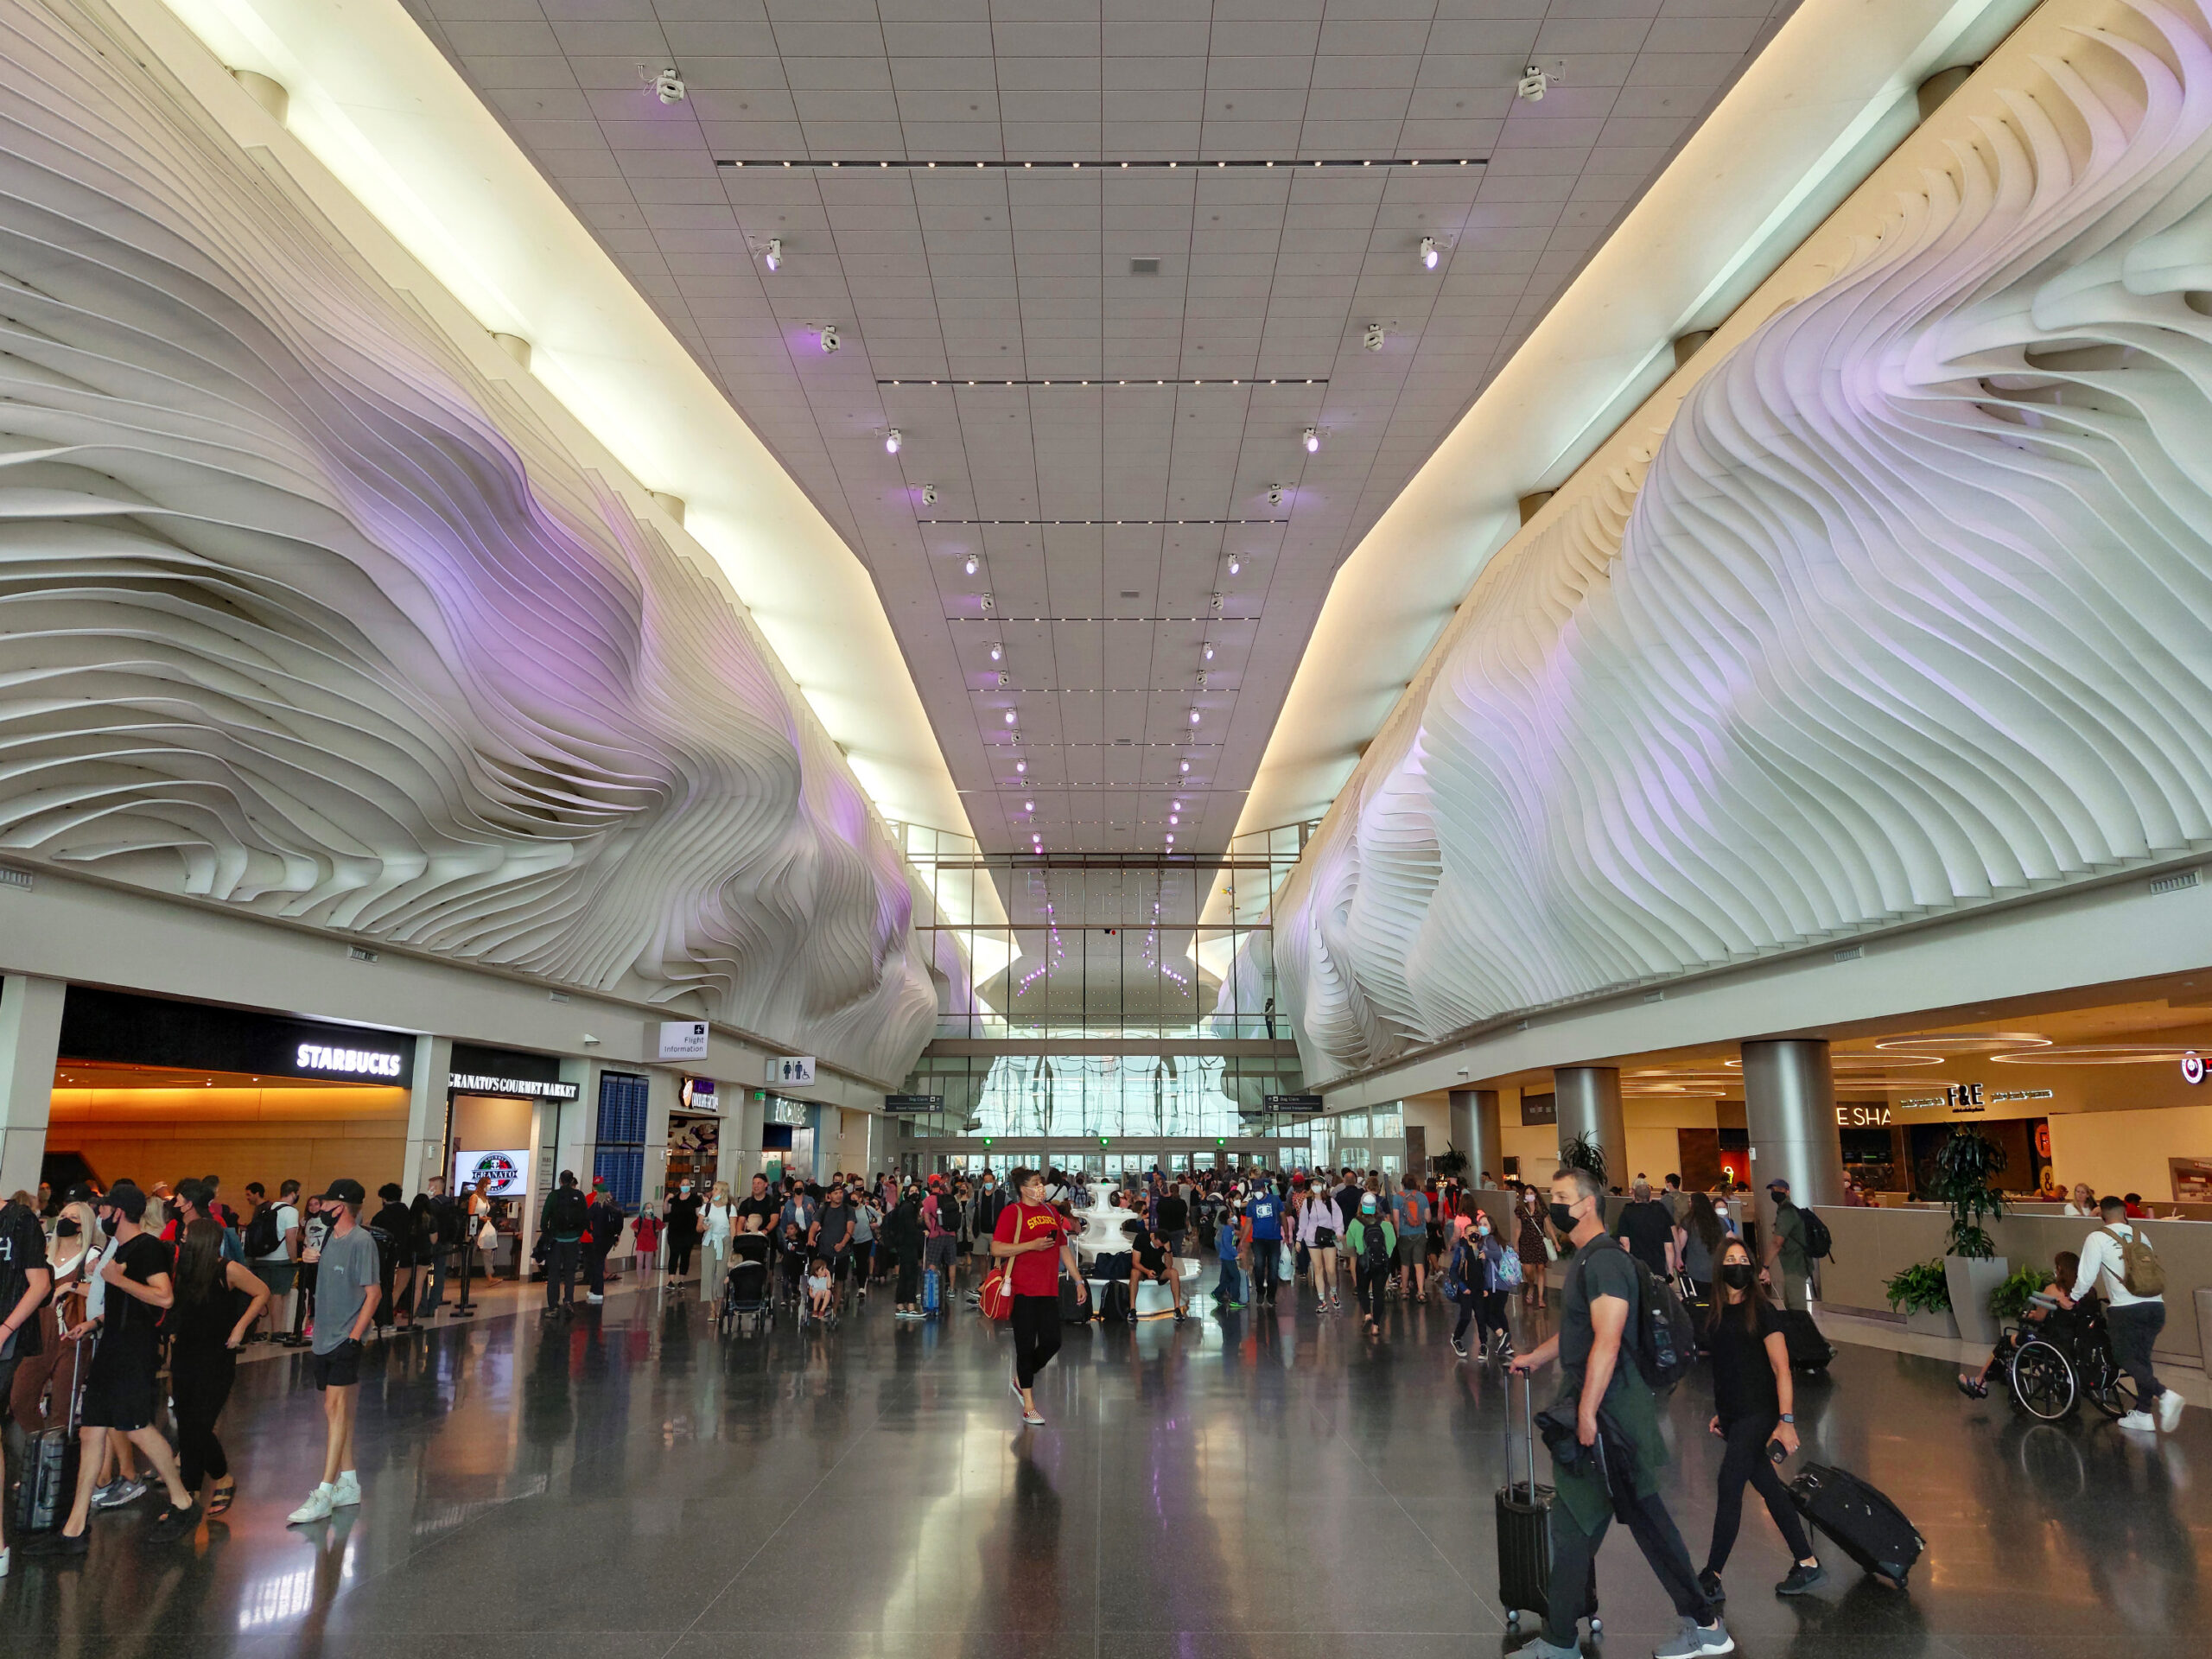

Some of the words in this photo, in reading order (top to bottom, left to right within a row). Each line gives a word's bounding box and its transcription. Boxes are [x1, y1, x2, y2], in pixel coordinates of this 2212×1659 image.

[296, 1044, 401, 1077] STARBUCKS
[499, 1078, 543, 1095] GOURMET
[543, 1083, 576, 1097] MARKET
[1947, 1084, 1985, 1107] F&E
[474, 1170, 515, 1179] GRANATO
